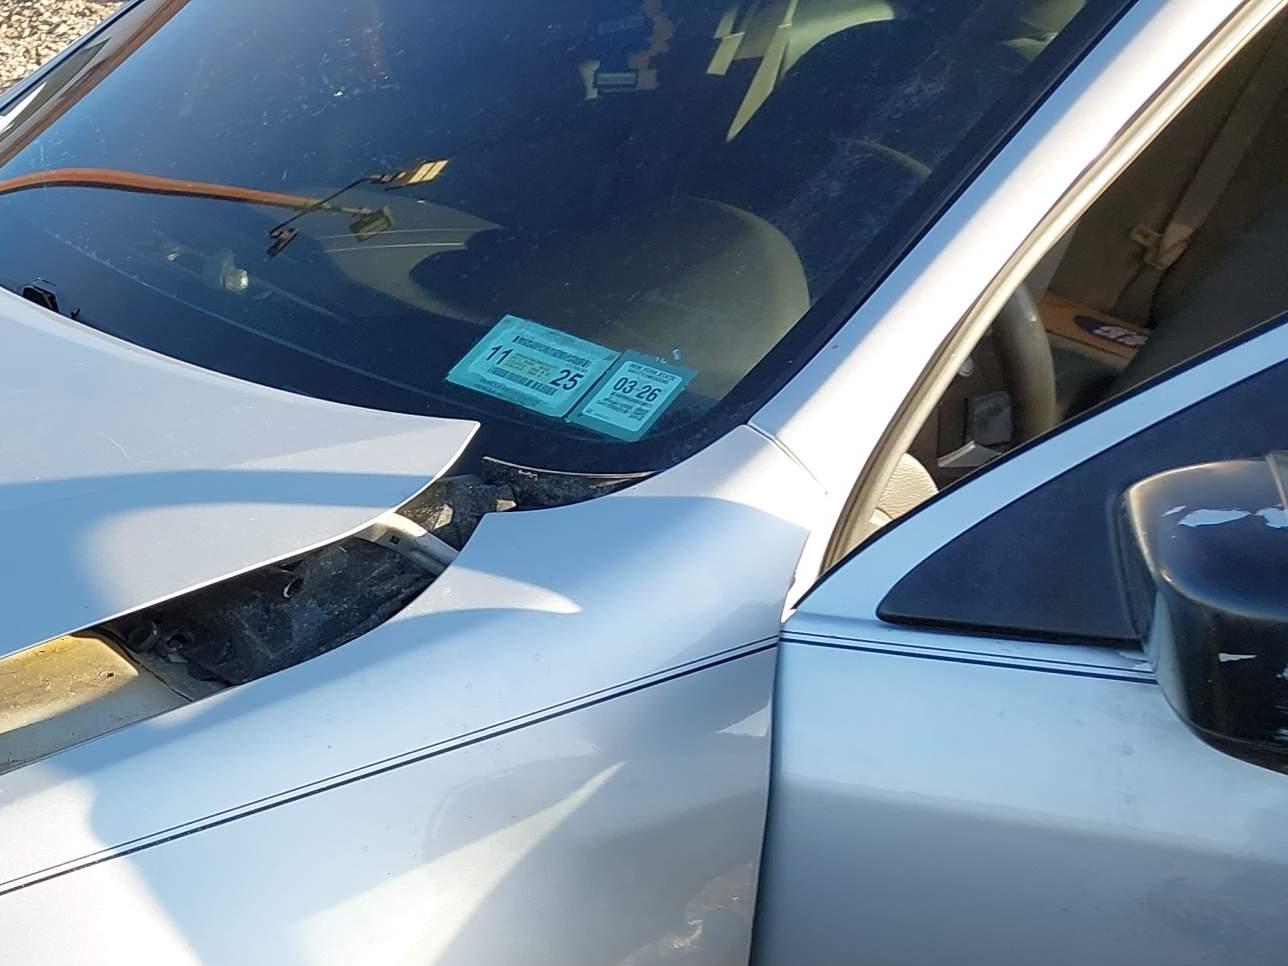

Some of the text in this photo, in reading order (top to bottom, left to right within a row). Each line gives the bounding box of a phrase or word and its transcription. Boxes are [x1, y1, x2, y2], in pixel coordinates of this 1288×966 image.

[486, 345, 514, 365] 11
[550, 368, 585, 391] 25
[613, 376, 662, 402] 03-26
